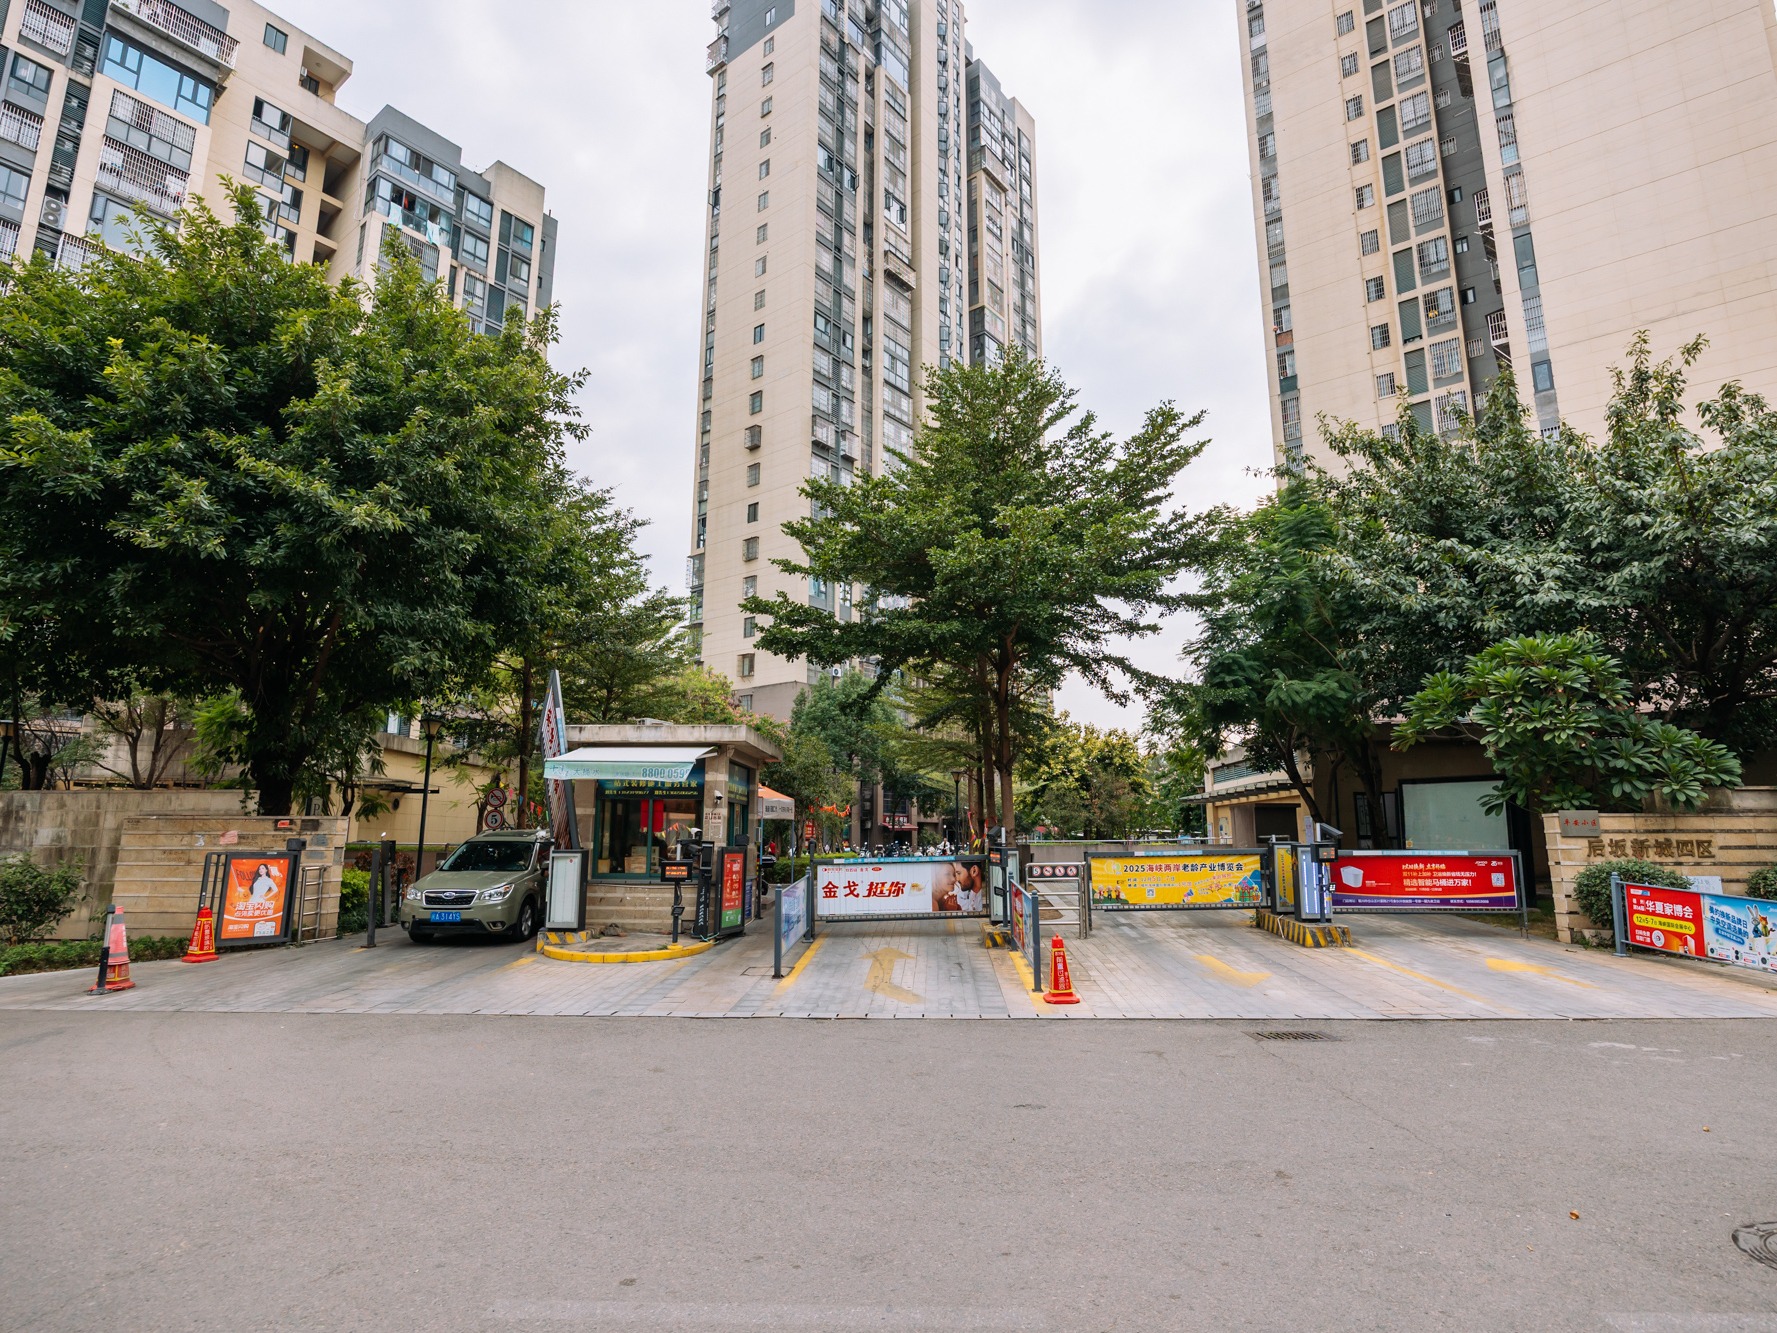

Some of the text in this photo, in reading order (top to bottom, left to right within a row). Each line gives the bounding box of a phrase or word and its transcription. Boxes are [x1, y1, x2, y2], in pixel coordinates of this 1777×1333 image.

[642, 767, 664, 778] 8800
[490, 814, 498, 824] 5
[1563, 818, 1597, 827] 平安小区
[1586, 838, 1716, 858] 后坂新城四区
[1124, 862, 1244, 873] 2025海峡两岸老龄产业博览会
[822, 880, 906, 898] 金戈 挺你
[236, 900, 274, 910] 淘宝闪购
[1646, 900, 1693, 918] 华夏家博会
